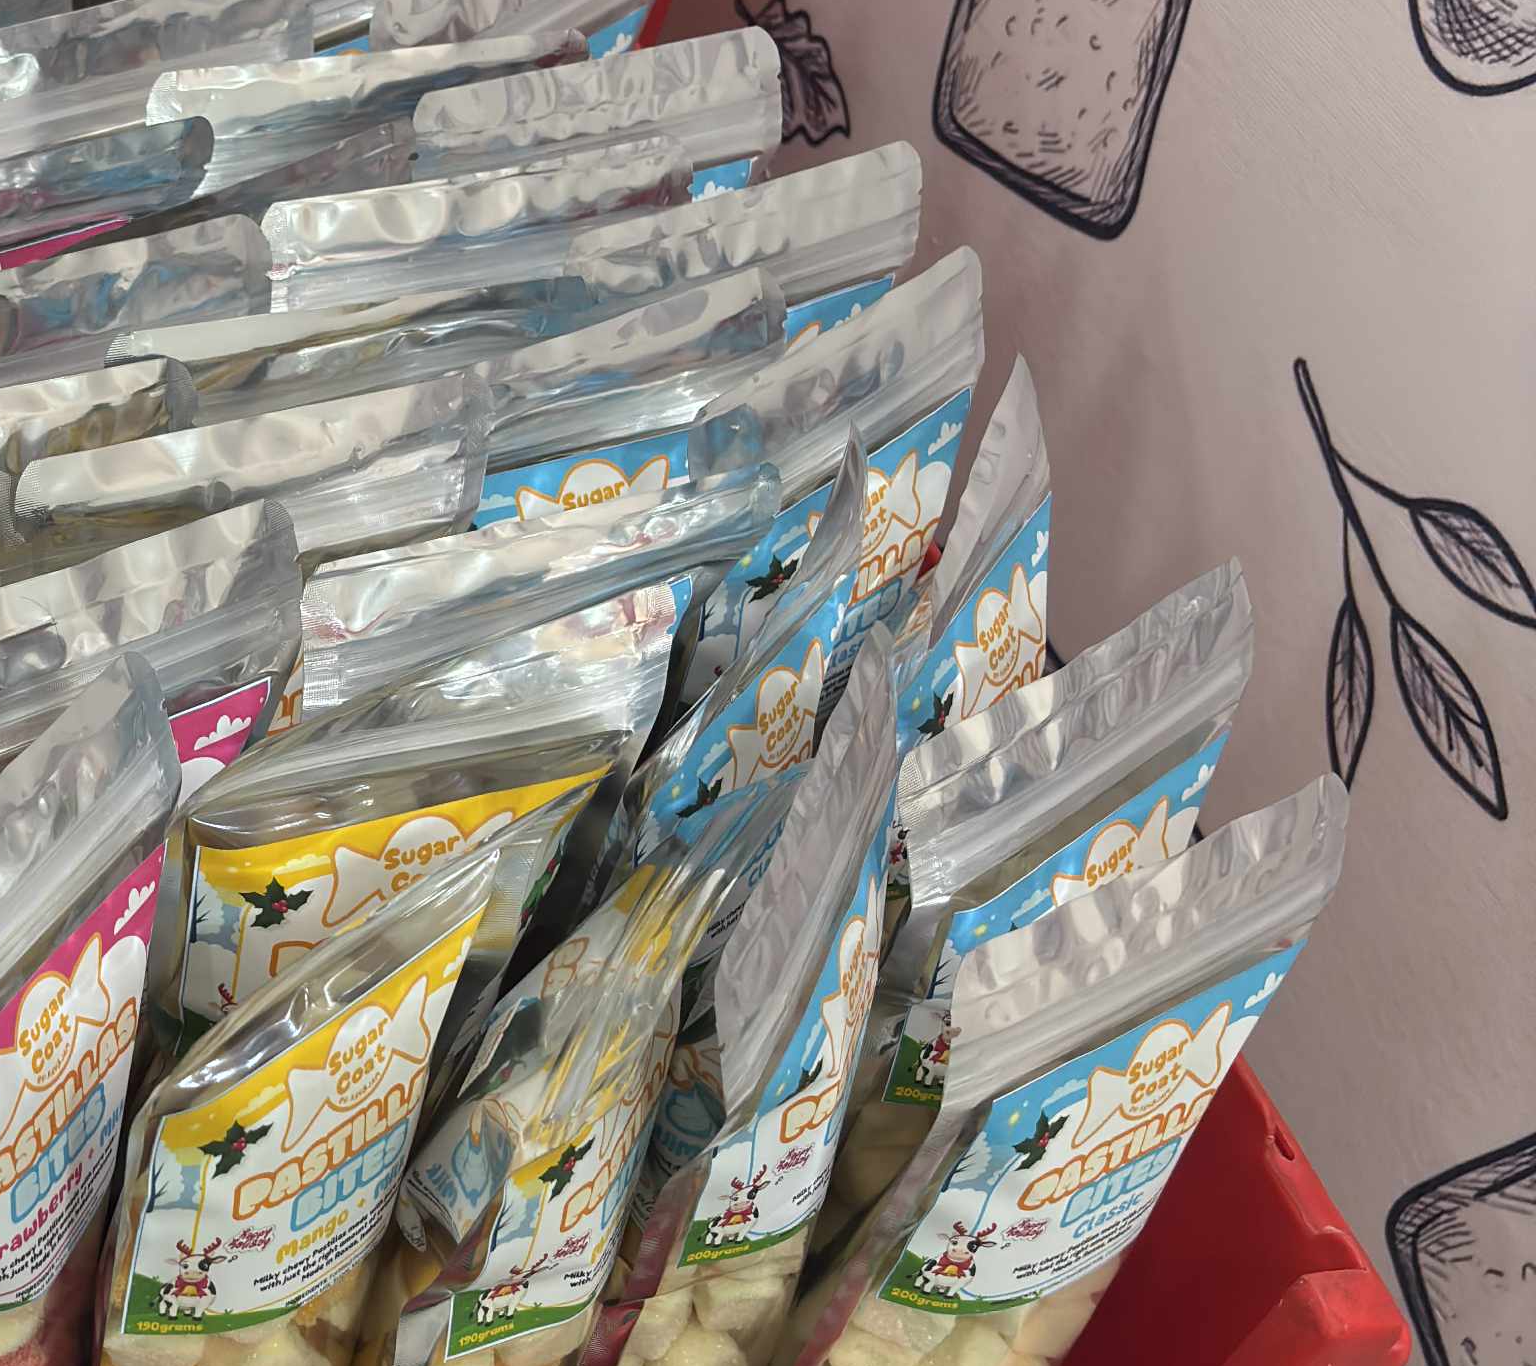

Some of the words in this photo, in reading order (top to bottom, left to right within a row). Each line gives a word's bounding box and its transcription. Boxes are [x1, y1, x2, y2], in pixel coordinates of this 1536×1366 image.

[979, 602, 1009, 652] Sugar
[989, 624, 1016, 669] Coat
[757, 681, 799, 734] Sugar
[766, 704, 801, 752] Coat
[383, 834, 460, 871] Sugar
[1086, 836, 1137, 888] Sugar
[19, 986, 66, 1057] Sugar
[31, 1013, 71, 1074] Coat
[328, 1018, 389, 1076] Sugar
[336, 1043, 385, 1095] Coat
[1128, 1038, 1189, 1084] Sugar
[1130, 1062, 1182, 1103] Coat
[11, 1082, 106, 1223] BITES
[290, 1116, 409, 1233] BITES
[1060, 1137, 1182, 1227] BITES
[276, 1208, 349, 1264] Mango
[686, 1244, 751, 1262] 200grams
[253, 1270, 281, 1285] Milky
[260, 1278, 281, 1291] with
[890, 1287, 959, 1310] 200grams
[136, 1321, 204, 1333] 190grams
[458, 1323, 514, 1347] 190grams
